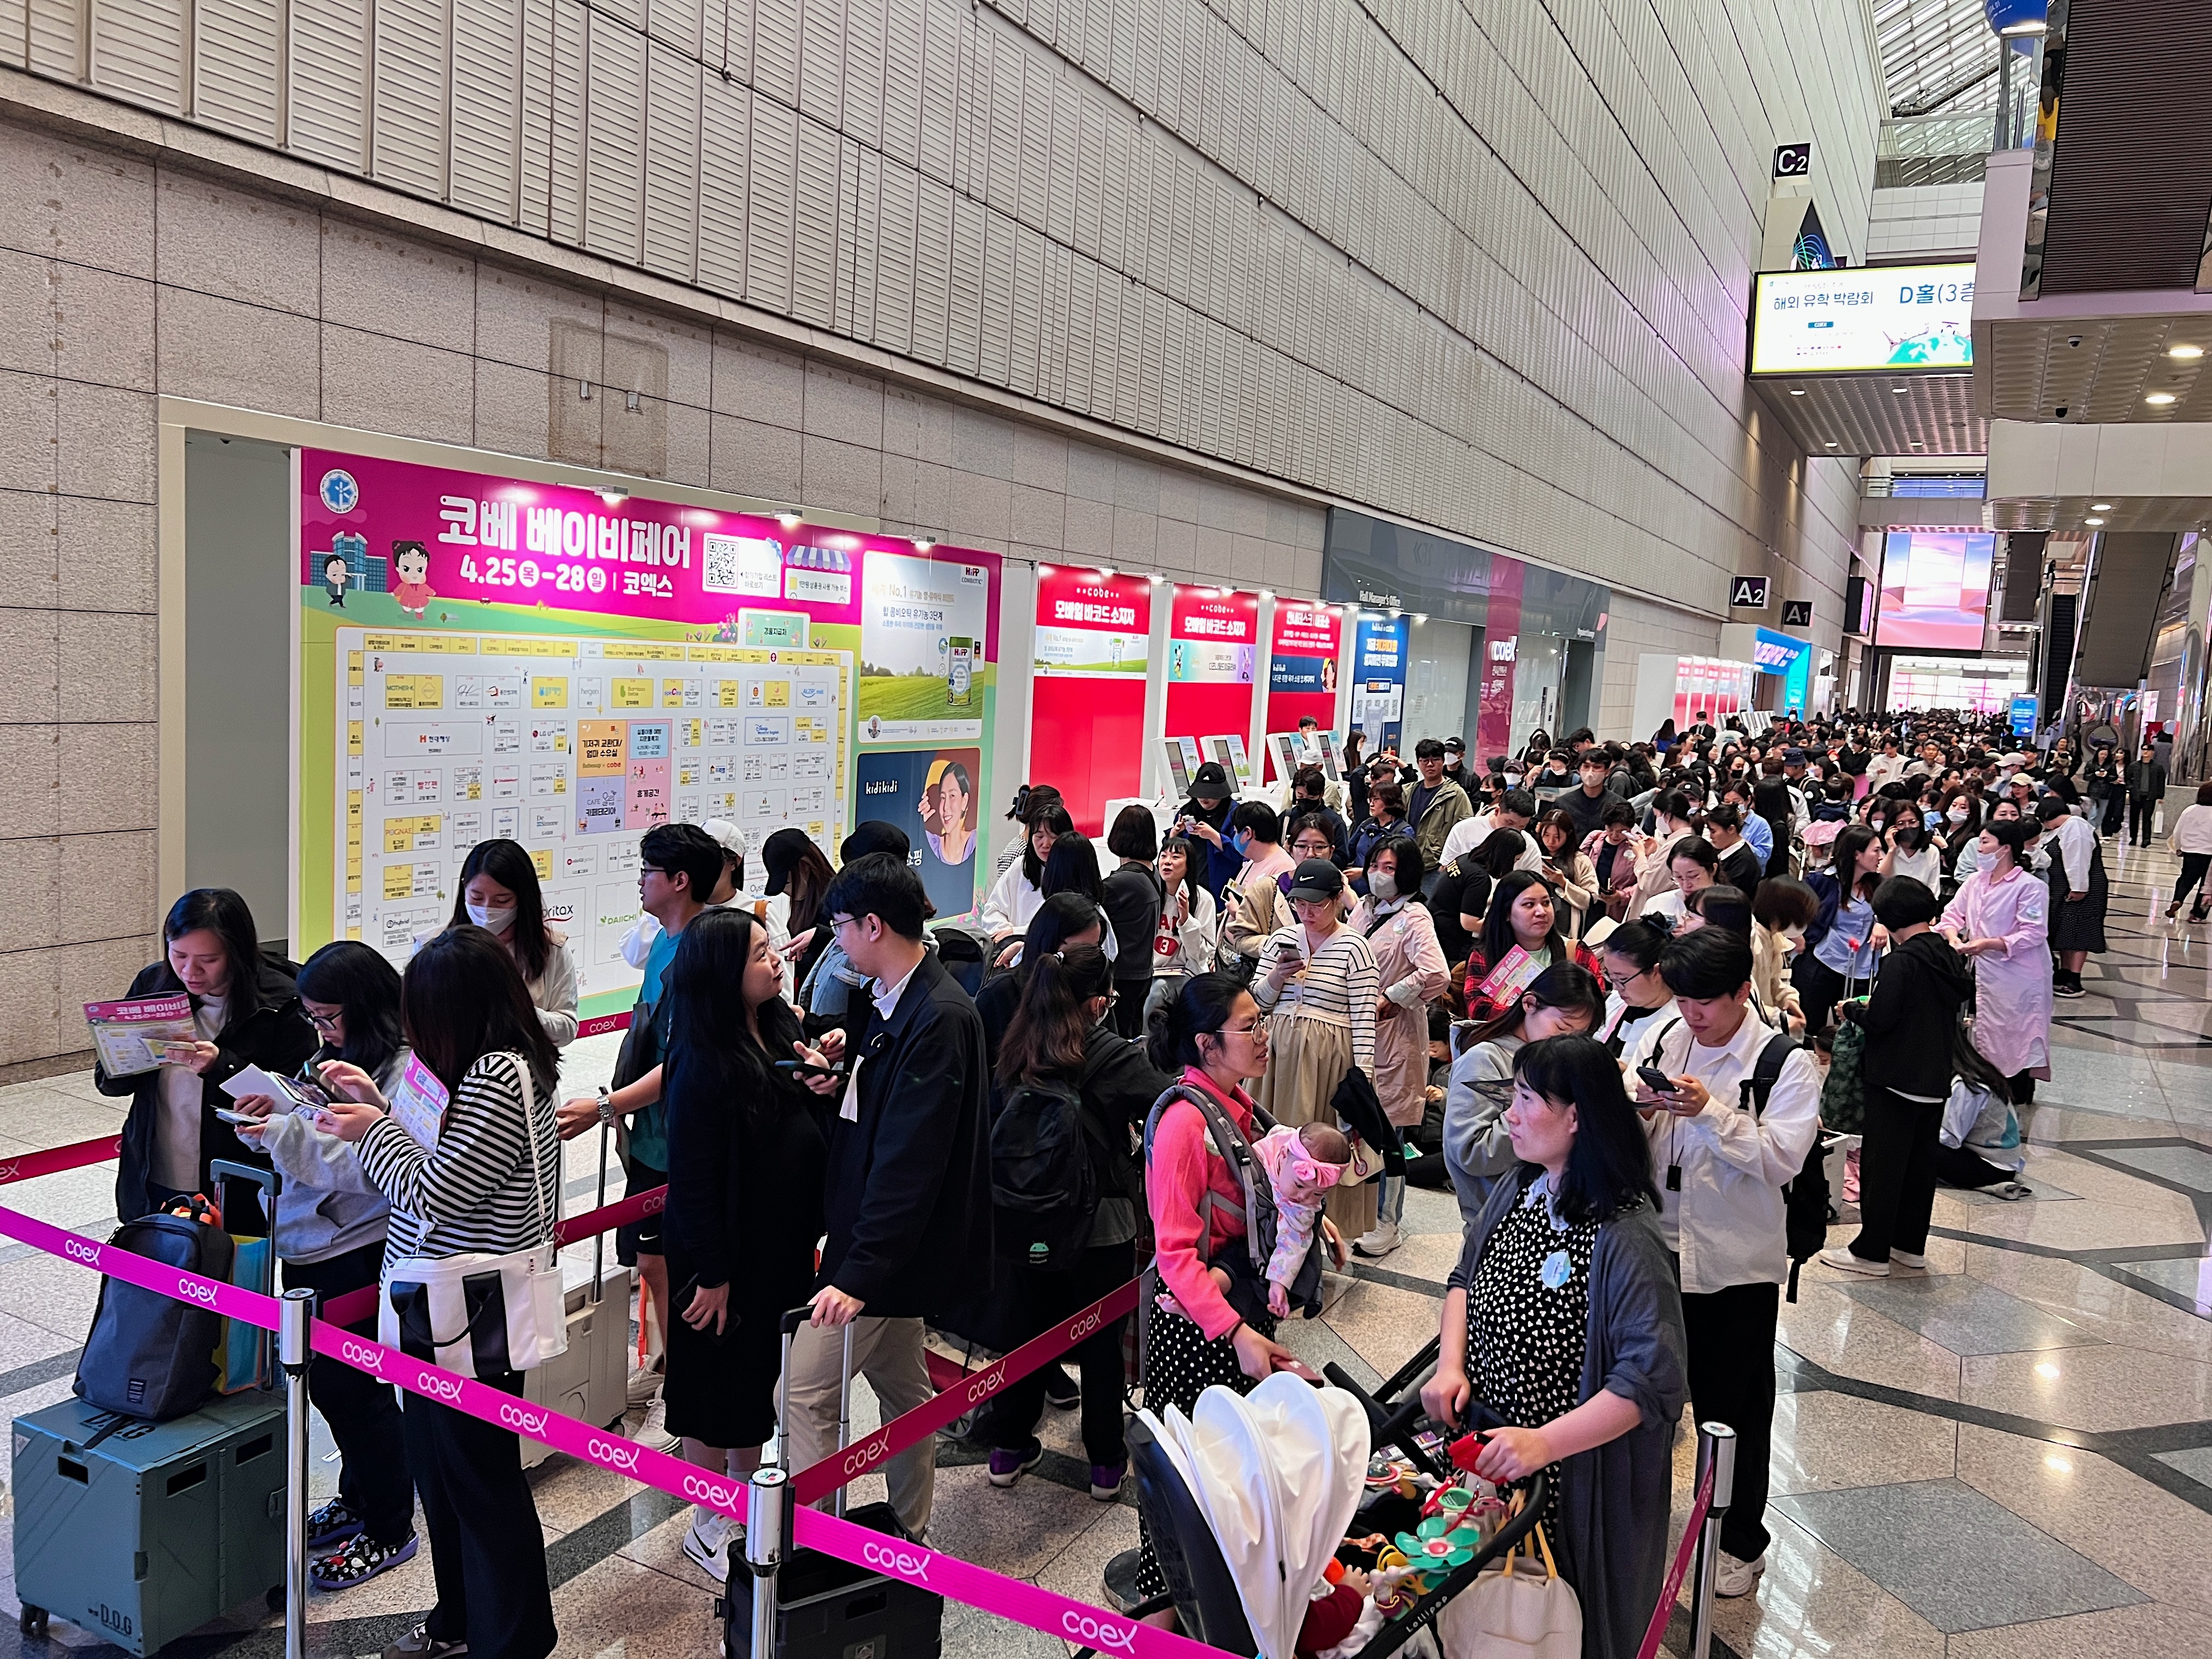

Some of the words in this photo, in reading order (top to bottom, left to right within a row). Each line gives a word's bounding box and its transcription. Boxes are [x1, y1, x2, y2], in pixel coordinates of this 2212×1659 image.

[1778, 149, 1808, 173] C2
[1774, 296, 1799, 310] 해외
[1803, 293, 1830, 307] 유학
[1833, 291, 1874, 306] 박람회
[437, 494, 517, 551] 코베
[526, 506, 691, 569] 베이비페어
[623, 571, 674, 599] 코엑스
[889, 583, 907, 598] No.1
[909, 589, 922, 600] 유기농
[1087, 586, 1109, 599] cobe
[1734, 580, 1764, 603] A2
[883, 606, 888, 617] 힙
[889, 606, 912, 618] 콤비오틱
[913, 608, 929, 620] 유기농
[929, 610, 943, 621] 3단계
[1055, 600, 1084, 621] 모바일
[1084, 603, 1110, 623] 바코드
[1110, 606, 1135, 626] 소지자
[1209, 603, 1226, 614] cobe
[1786, 604, 1809, 623] A1
[1492, 635, 1518, 662] coex
[580, 688, 599, 697] hegen
[582, 739, 600, 748] 기저귀
[586, 749, 599, 758] 엄마
[600, 749, 618, 758] 수유실
[637, 789, 659, 798] 휴게공간
[865, 780, 898, 794] kidikidi
[585, 808, 616, 816] 카페테리아
[607, 914, 637, 925] DAIICHI
[1160, 939, 1169, 953] 3
[143, 998, 191, 1013] 베이비페
[589, 1015, 617, 1034] coex
[0, 1159, 20, 1180] ex
[642, 1192, 667, 1212] coe
[64, 1238, 101, 1266] coex
[178, 1278, 219, 1306] coex
[1070, 1303, 1102, 1341] coex
[341, 1340, 385, 1372] coex
[416, 1372, 464, 1404] coex
[967, 1360, 1006, 1403] coex
[500, 1403, 549, 1438] coex
[588, 1438, 640, 1474] coex
[843, 1427, 890, 1476] coex
[682, 1475, 741, 1514] coex
[862, 1541, 932, 1583] coex
[1406, 1595, 1448, 1633] Lollipop
[1061, 1610, 1138, 1656] coex
